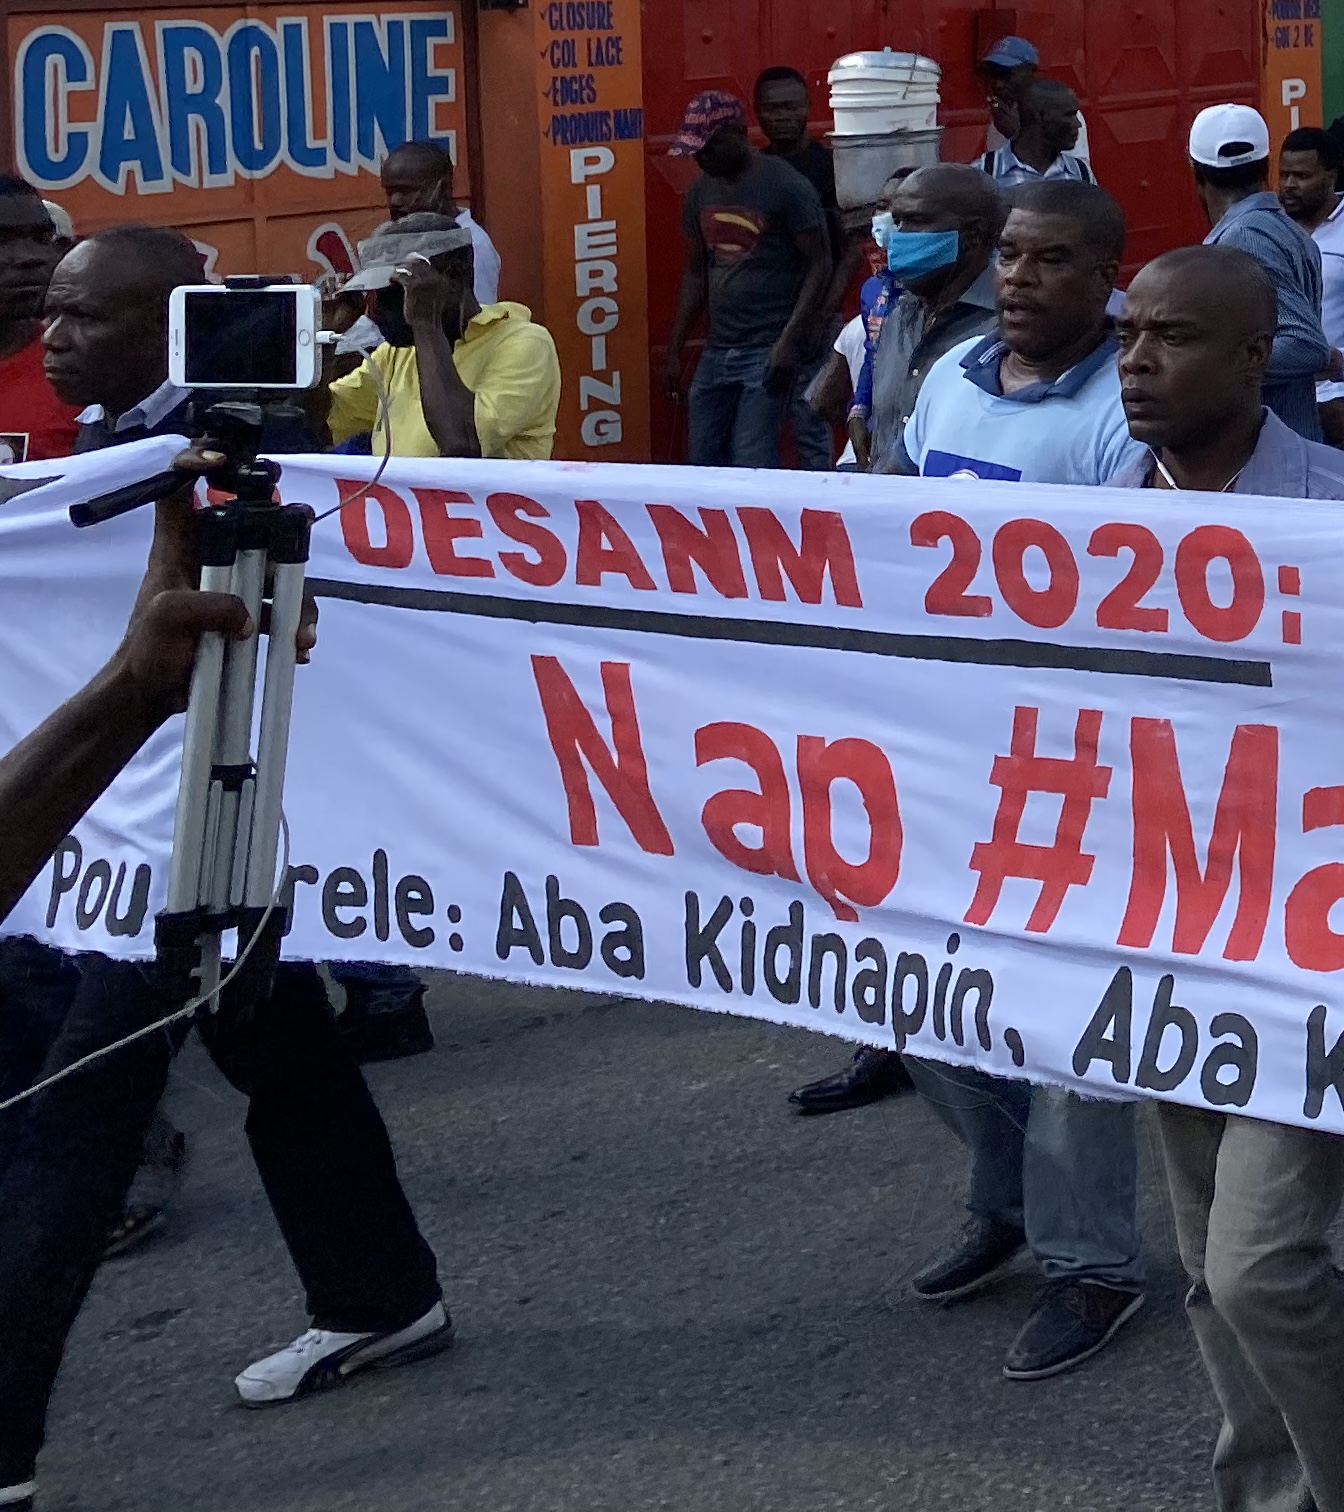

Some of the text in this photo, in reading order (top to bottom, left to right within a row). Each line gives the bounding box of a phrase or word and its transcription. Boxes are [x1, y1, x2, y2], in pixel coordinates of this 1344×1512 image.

[548, 0, 614, 31] CLOSURE
[550, 36, 623, 68] COL LACE
[551, 75, 597, 107] EDGES
[16, 12, 457, 196] CAROLINE
[570, 145, 623, 448] PIERCING
[335, 477, 864, 609] DESANM
[907, 509, 1302, 646] 2020:
[531, 654, 904, 923] Nap
[45, 834, 152, 938] Pou
[497, 871, 646, 980] Aba
[685, 892, 1026, 1067] Kidnapin,
[1071, 965, 1258, 1108] Aba
